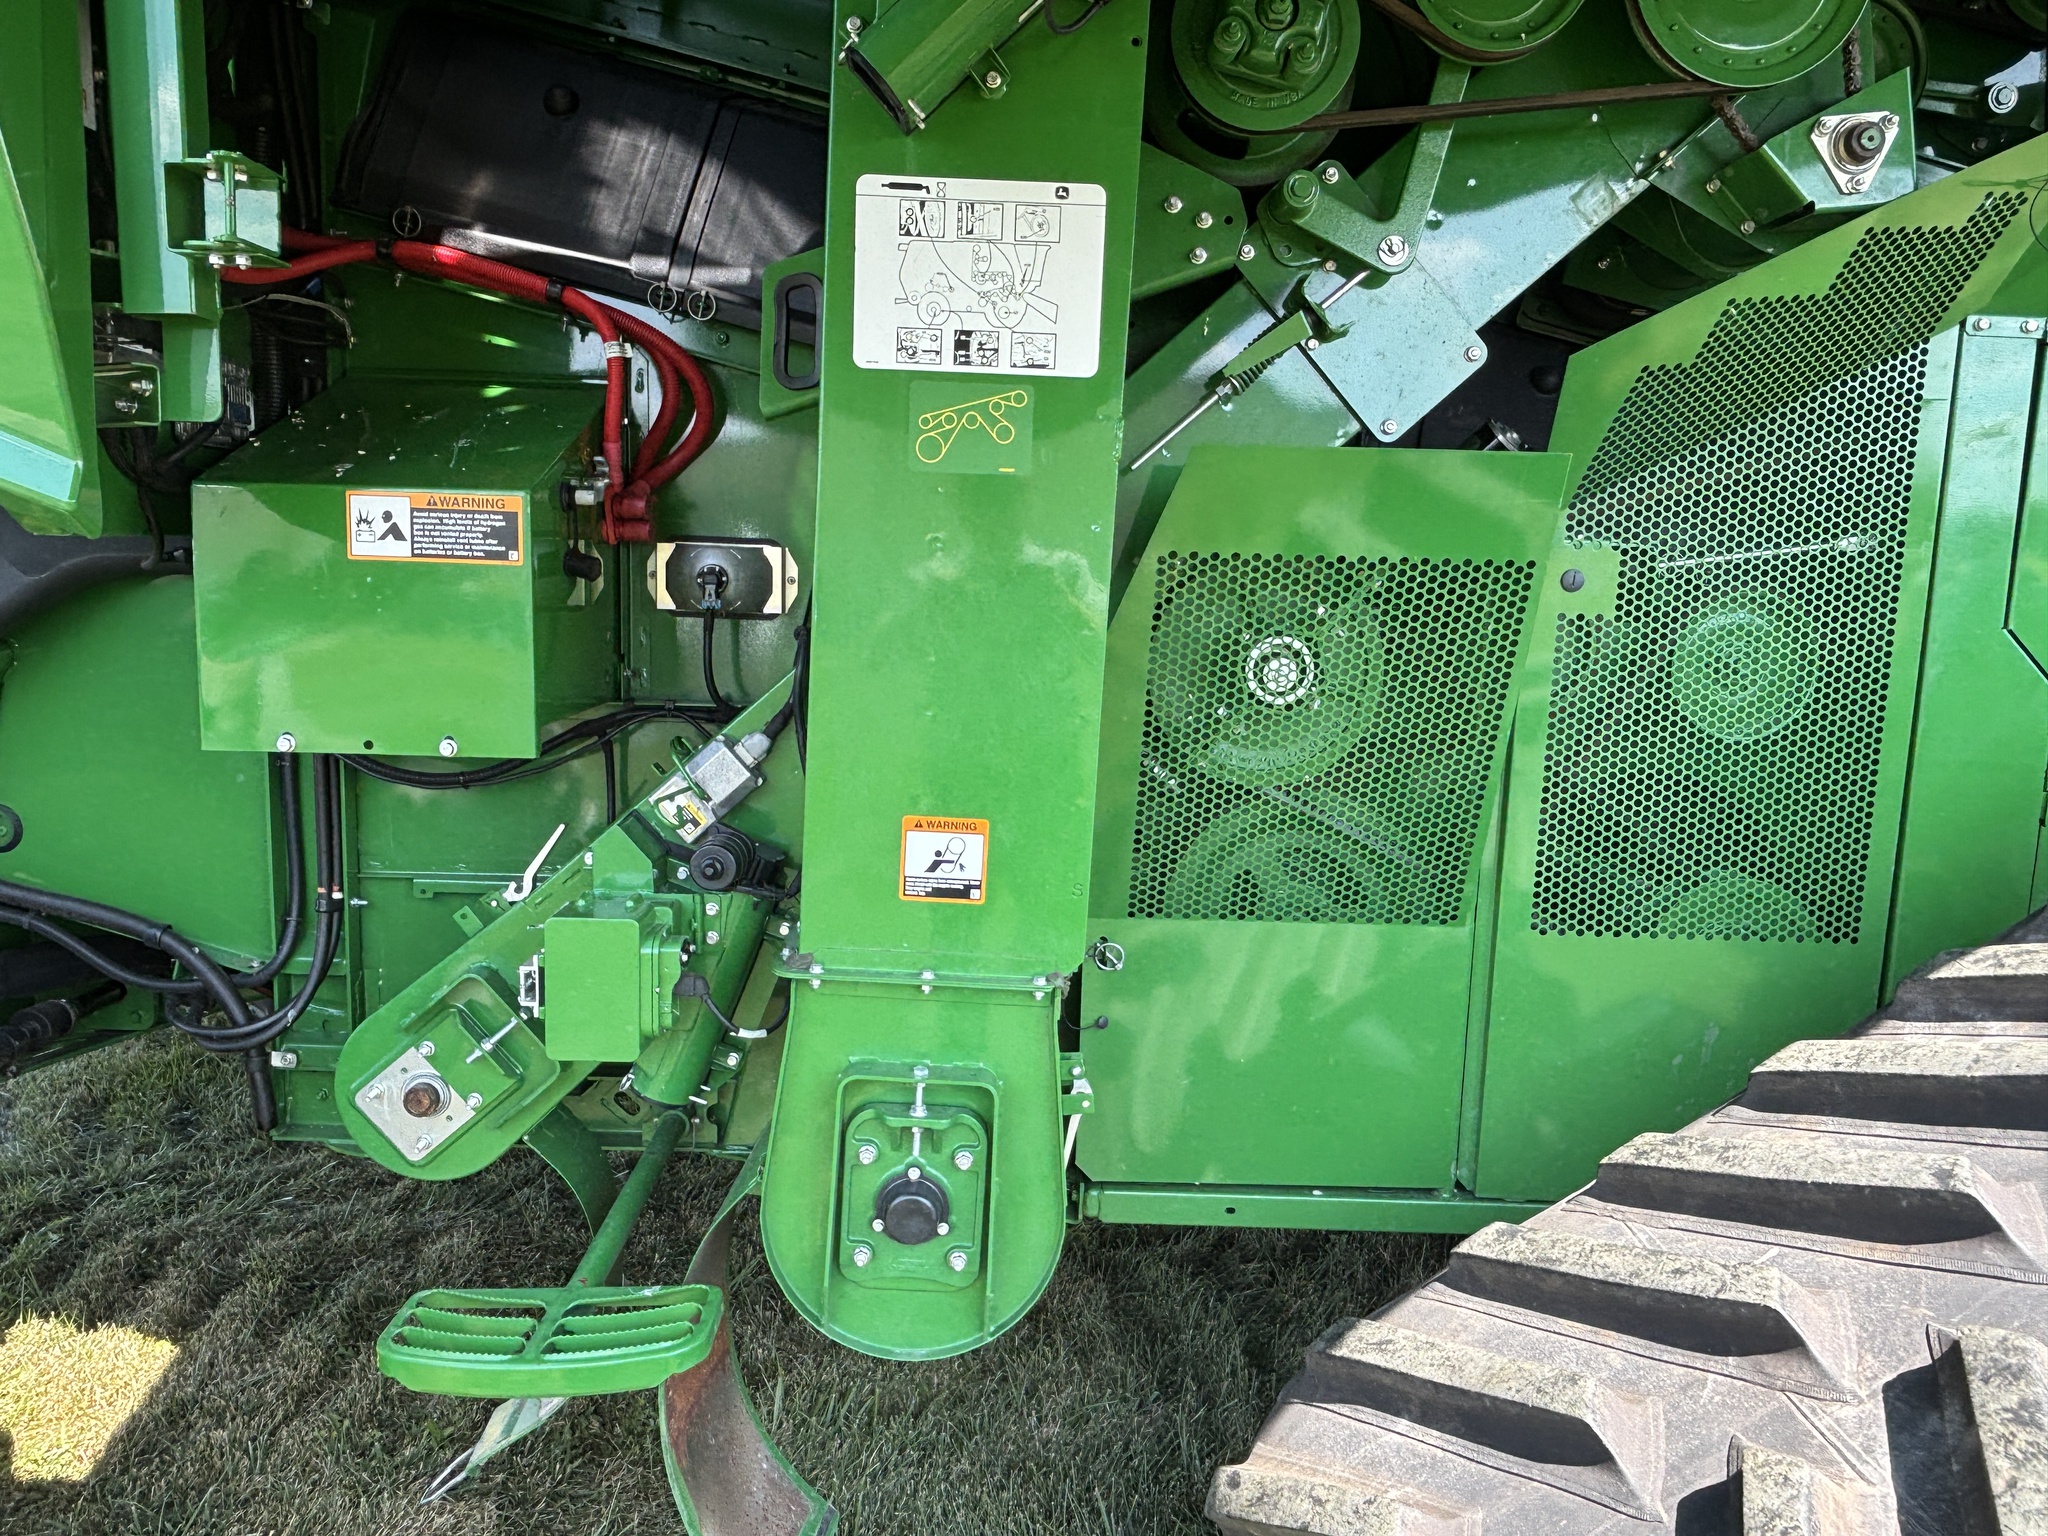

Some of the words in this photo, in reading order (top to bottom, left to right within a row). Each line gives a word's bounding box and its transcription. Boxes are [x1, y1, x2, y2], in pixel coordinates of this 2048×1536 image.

[1282, 90, 1305, 105] USA
[439, 496, 505, 509] WARNING
[926, 820, 977, 831] WARNING
